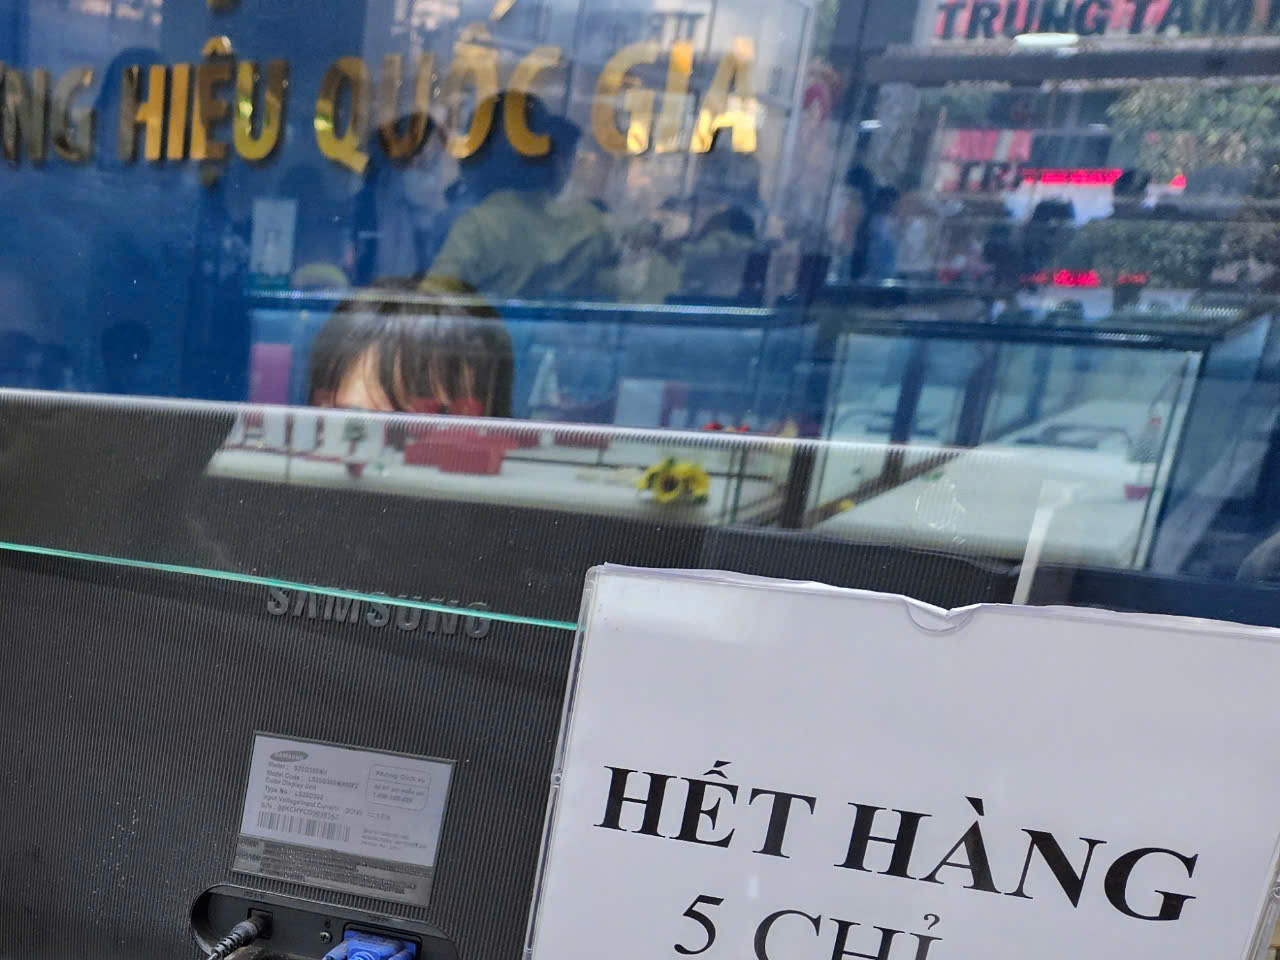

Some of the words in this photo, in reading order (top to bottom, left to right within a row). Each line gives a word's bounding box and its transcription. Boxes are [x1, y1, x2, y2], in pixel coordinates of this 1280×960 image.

[119, 36, 289, 187] HIỆU
[314, 0, 562, 175] QUỐC
[591, 36, 761, 156] GIA
[266, 586, 491, 639] SAMSUNG
[594, 760, 816, 858] HẾT
[834, 796, 1198, 921] HÀNG
[674, 895, 724, 954] 5
